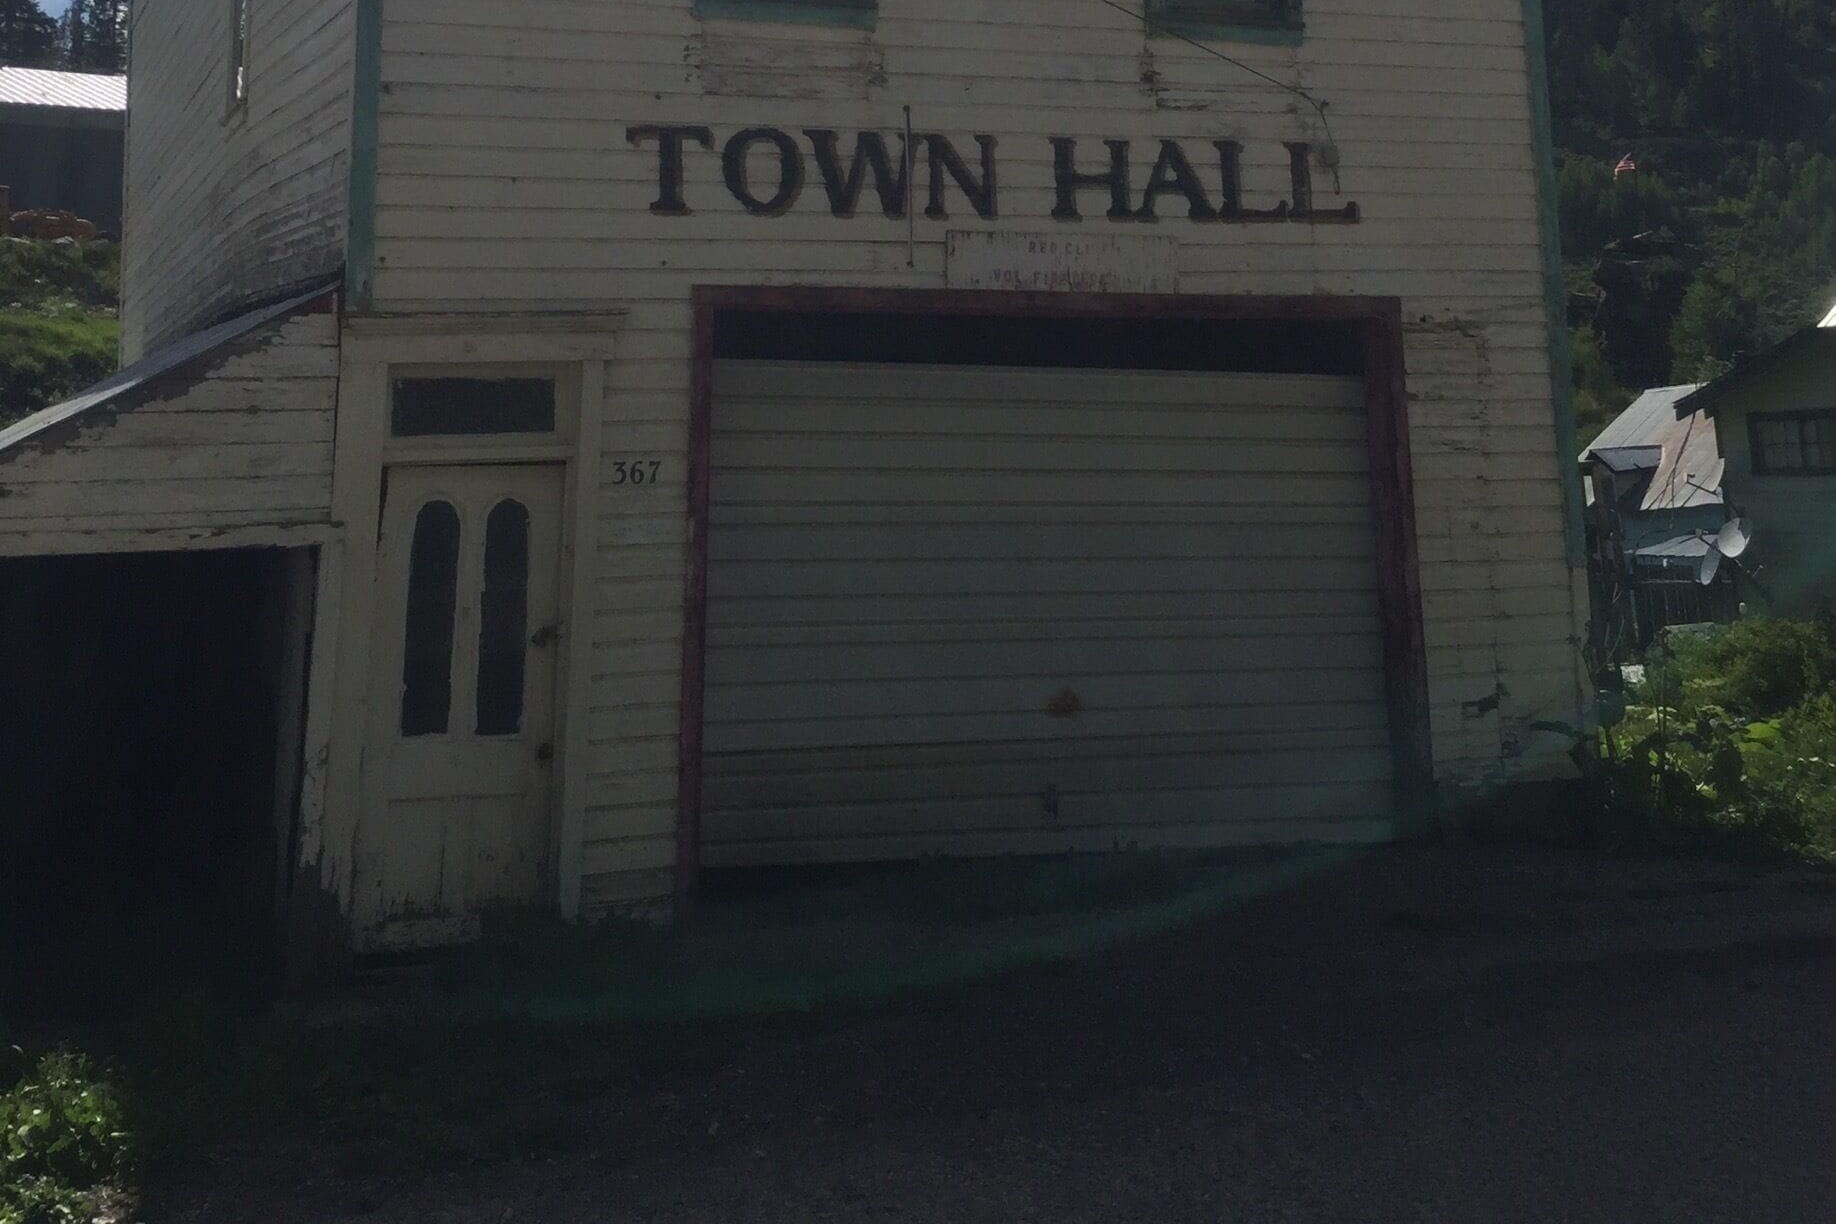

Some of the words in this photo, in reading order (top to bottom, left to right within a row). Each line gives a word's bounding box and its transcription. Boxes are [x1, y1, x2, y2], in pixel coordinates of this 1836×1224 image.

[625, 125, 998, 221] TOWN
[1048, 136, 1361, 225] HALL
[612, 460, 662, 485] 367
